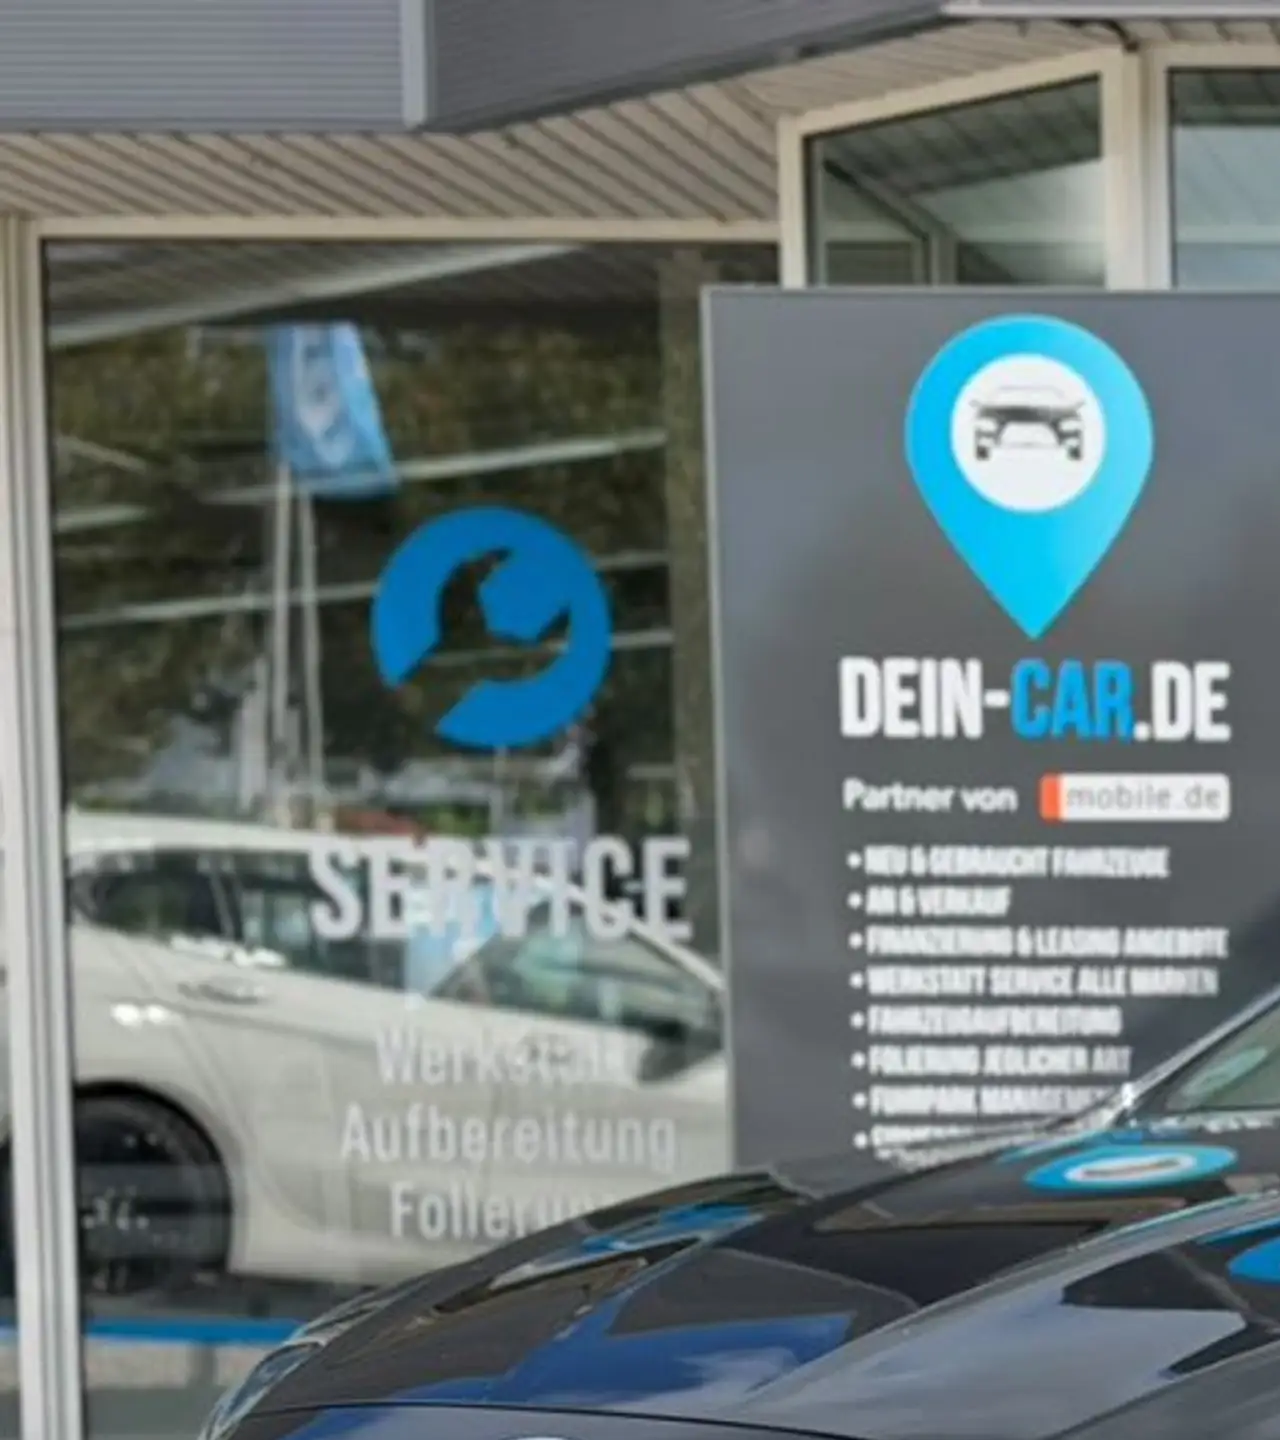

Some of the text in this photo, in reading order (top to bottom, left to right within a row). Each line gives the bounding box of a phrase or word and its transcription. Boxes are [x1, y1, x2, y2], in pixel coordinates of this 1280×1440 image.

[840, 656, 1231, 742] DEIN-CAR.DE
[842, 777, 1221, 813] Partner von mobile.de
[308, 834, 694, 942] SERVICE
[340, 1102, 678, 1172] Aufbereitung
